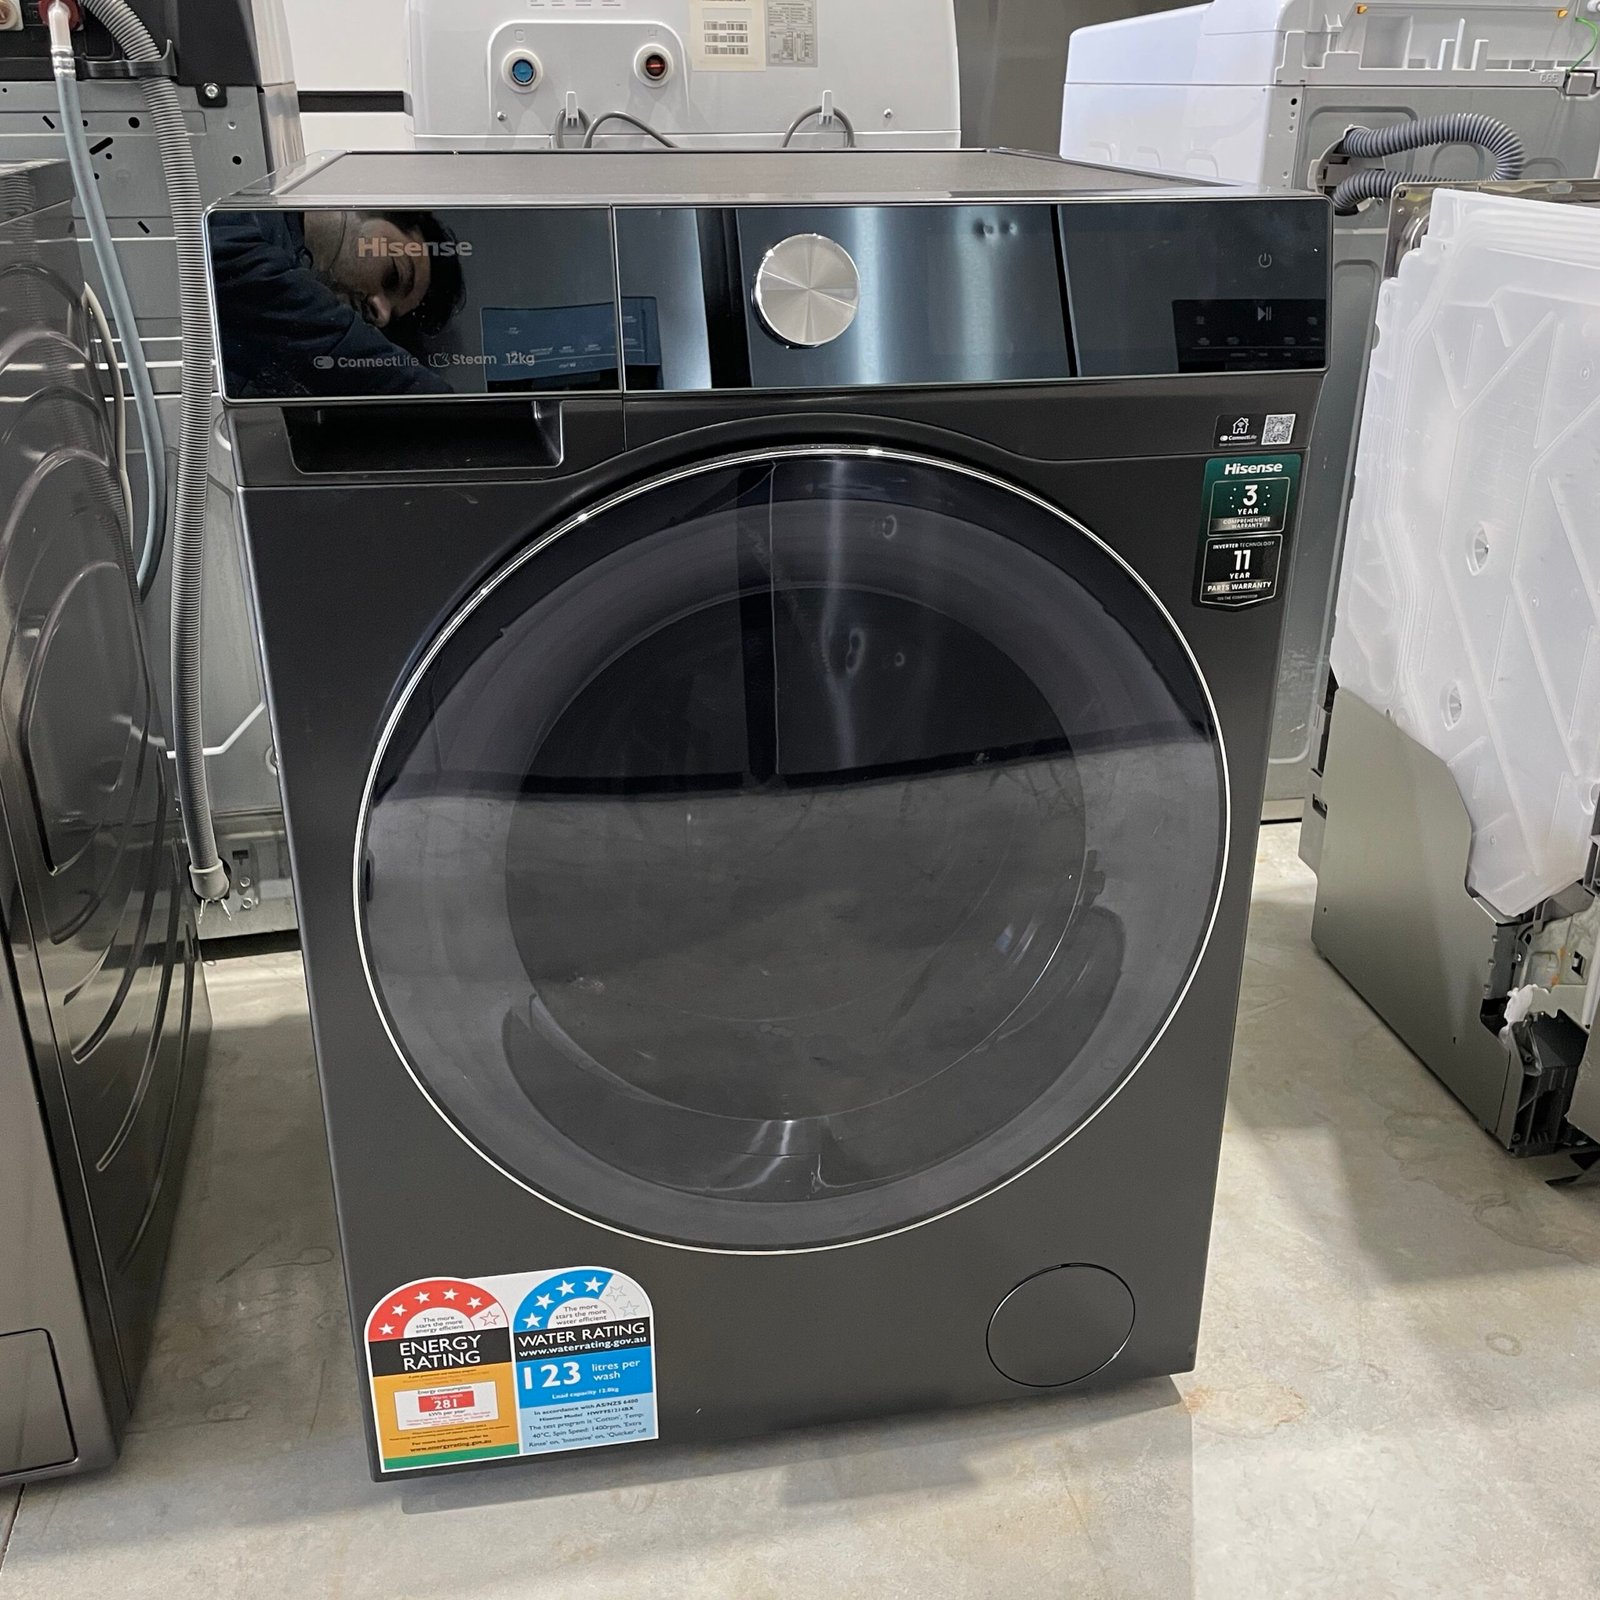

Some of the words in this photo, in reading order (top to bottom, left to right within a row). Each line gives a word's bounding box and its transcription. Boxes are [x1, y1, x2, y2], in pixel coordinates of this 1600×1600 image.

[358, 237, 473, 257] Hisense
[337, 355, 419, 368] ConnectLife
[452, 352, 497, 366] Steam
[505, 352, 535, 366] 12kg
[1224, 462, 1283, 475] Hisense
[1242, 484, 1258, 506] 3
[1237, 507, 1259, 515] YEAR
[1223, 516, 1271, 525] COMPREHENSIVE
[1239, 540, 1275, 548] TECHNOLOGY
[1233, 549, 1251, 571] 11
[1229, 572, 1251, 580] YEAR
[1207, 584, 1230, 592] PARTS
[1231, 581, 1272, 590] WARRANTY
[562, 1305, 577, 1313] The
[574, 1310, 586, 1318] the
[556, 1318, 577, 1326] water
[579, 1314, 607, 1323] efficient
[518, 1331, 576, 1347] WATER
[582, 1322, 645, 1340] RATING
[399, 1334, 482, 1357] ENERGY
[519, 1336, 647, 1357] www.waterrating.gov.au
[403, 1350, 481, 1371] RATING
[591, 1362, 619, 1372] litres
[622, 1360, 640, 1371] per
[523, 1361, 582, 1390] 123
[592, 1371, 621, 1381] wash
[552, 1392, 569, 1400] Load
[569, 1389, 597, 1399] capacity
[434, 1398, 458, 1410] 281
[557, 1420, 586, 1429] program
